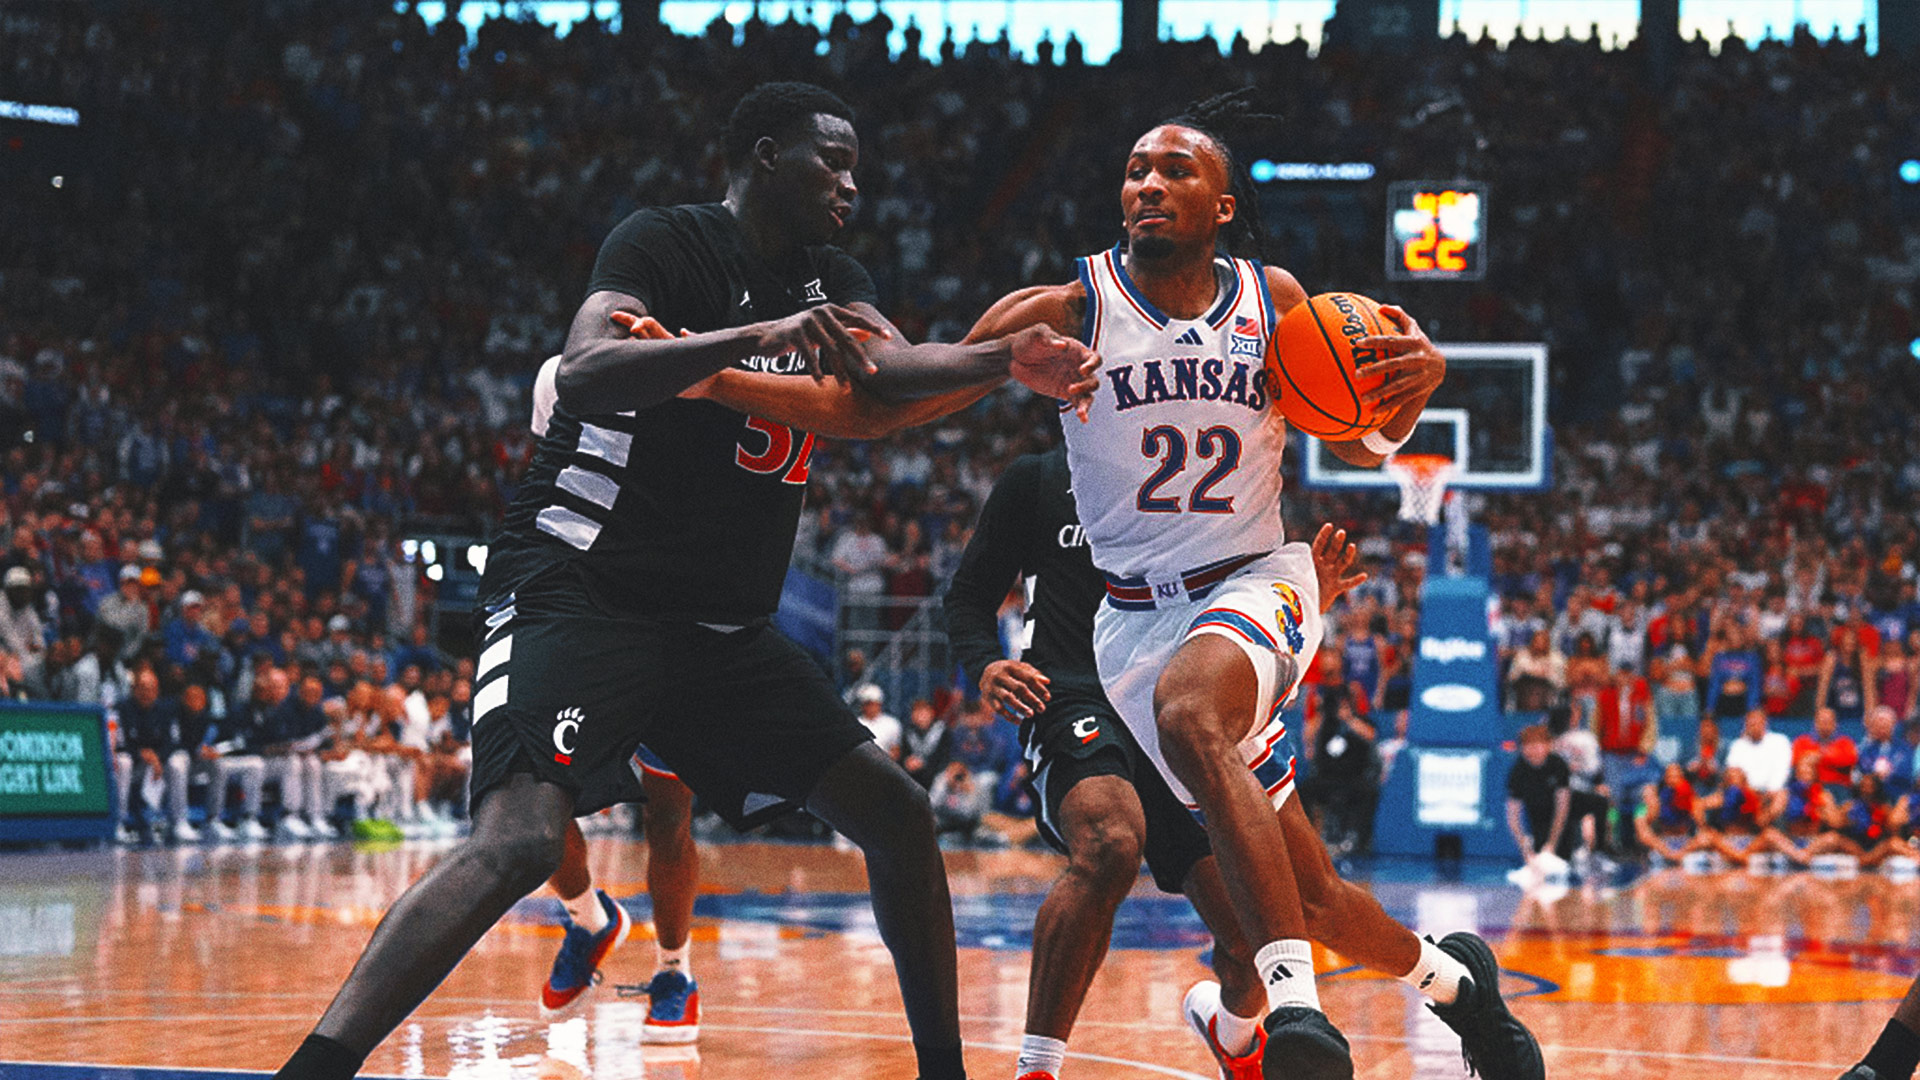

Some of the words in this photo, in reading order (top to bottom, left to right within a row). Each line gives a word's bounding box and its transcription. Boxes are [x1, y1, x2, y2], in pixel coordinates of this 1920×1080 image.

[1106, 358, 1267, 411] KANSAS
[1137, 424, 1243, 514] 22
[1157, 582, 1179, 598] KU
